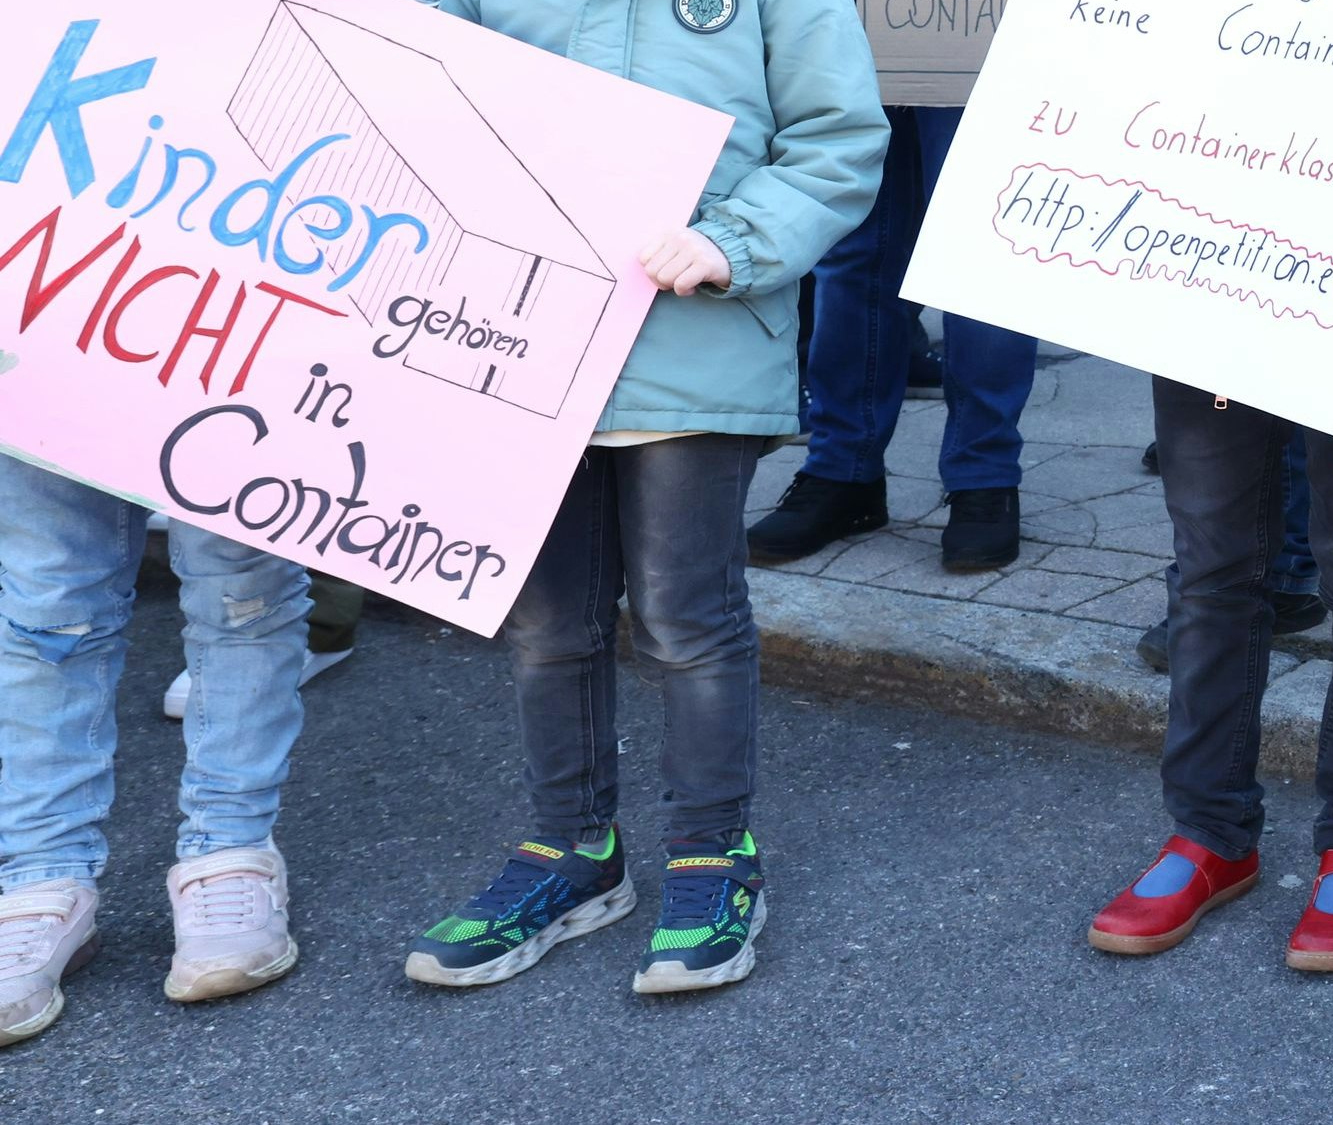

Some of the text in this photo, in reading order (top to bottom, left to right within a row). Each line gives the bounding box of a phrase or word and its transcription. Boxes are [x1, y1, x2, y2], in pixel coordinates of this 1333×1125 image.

[0, 18, 529, 359] Kinder gehören
[0, 204, 349, 396] NICHT
[293, 362, 352, 428] in
[159, 403, 506, 601] Container
